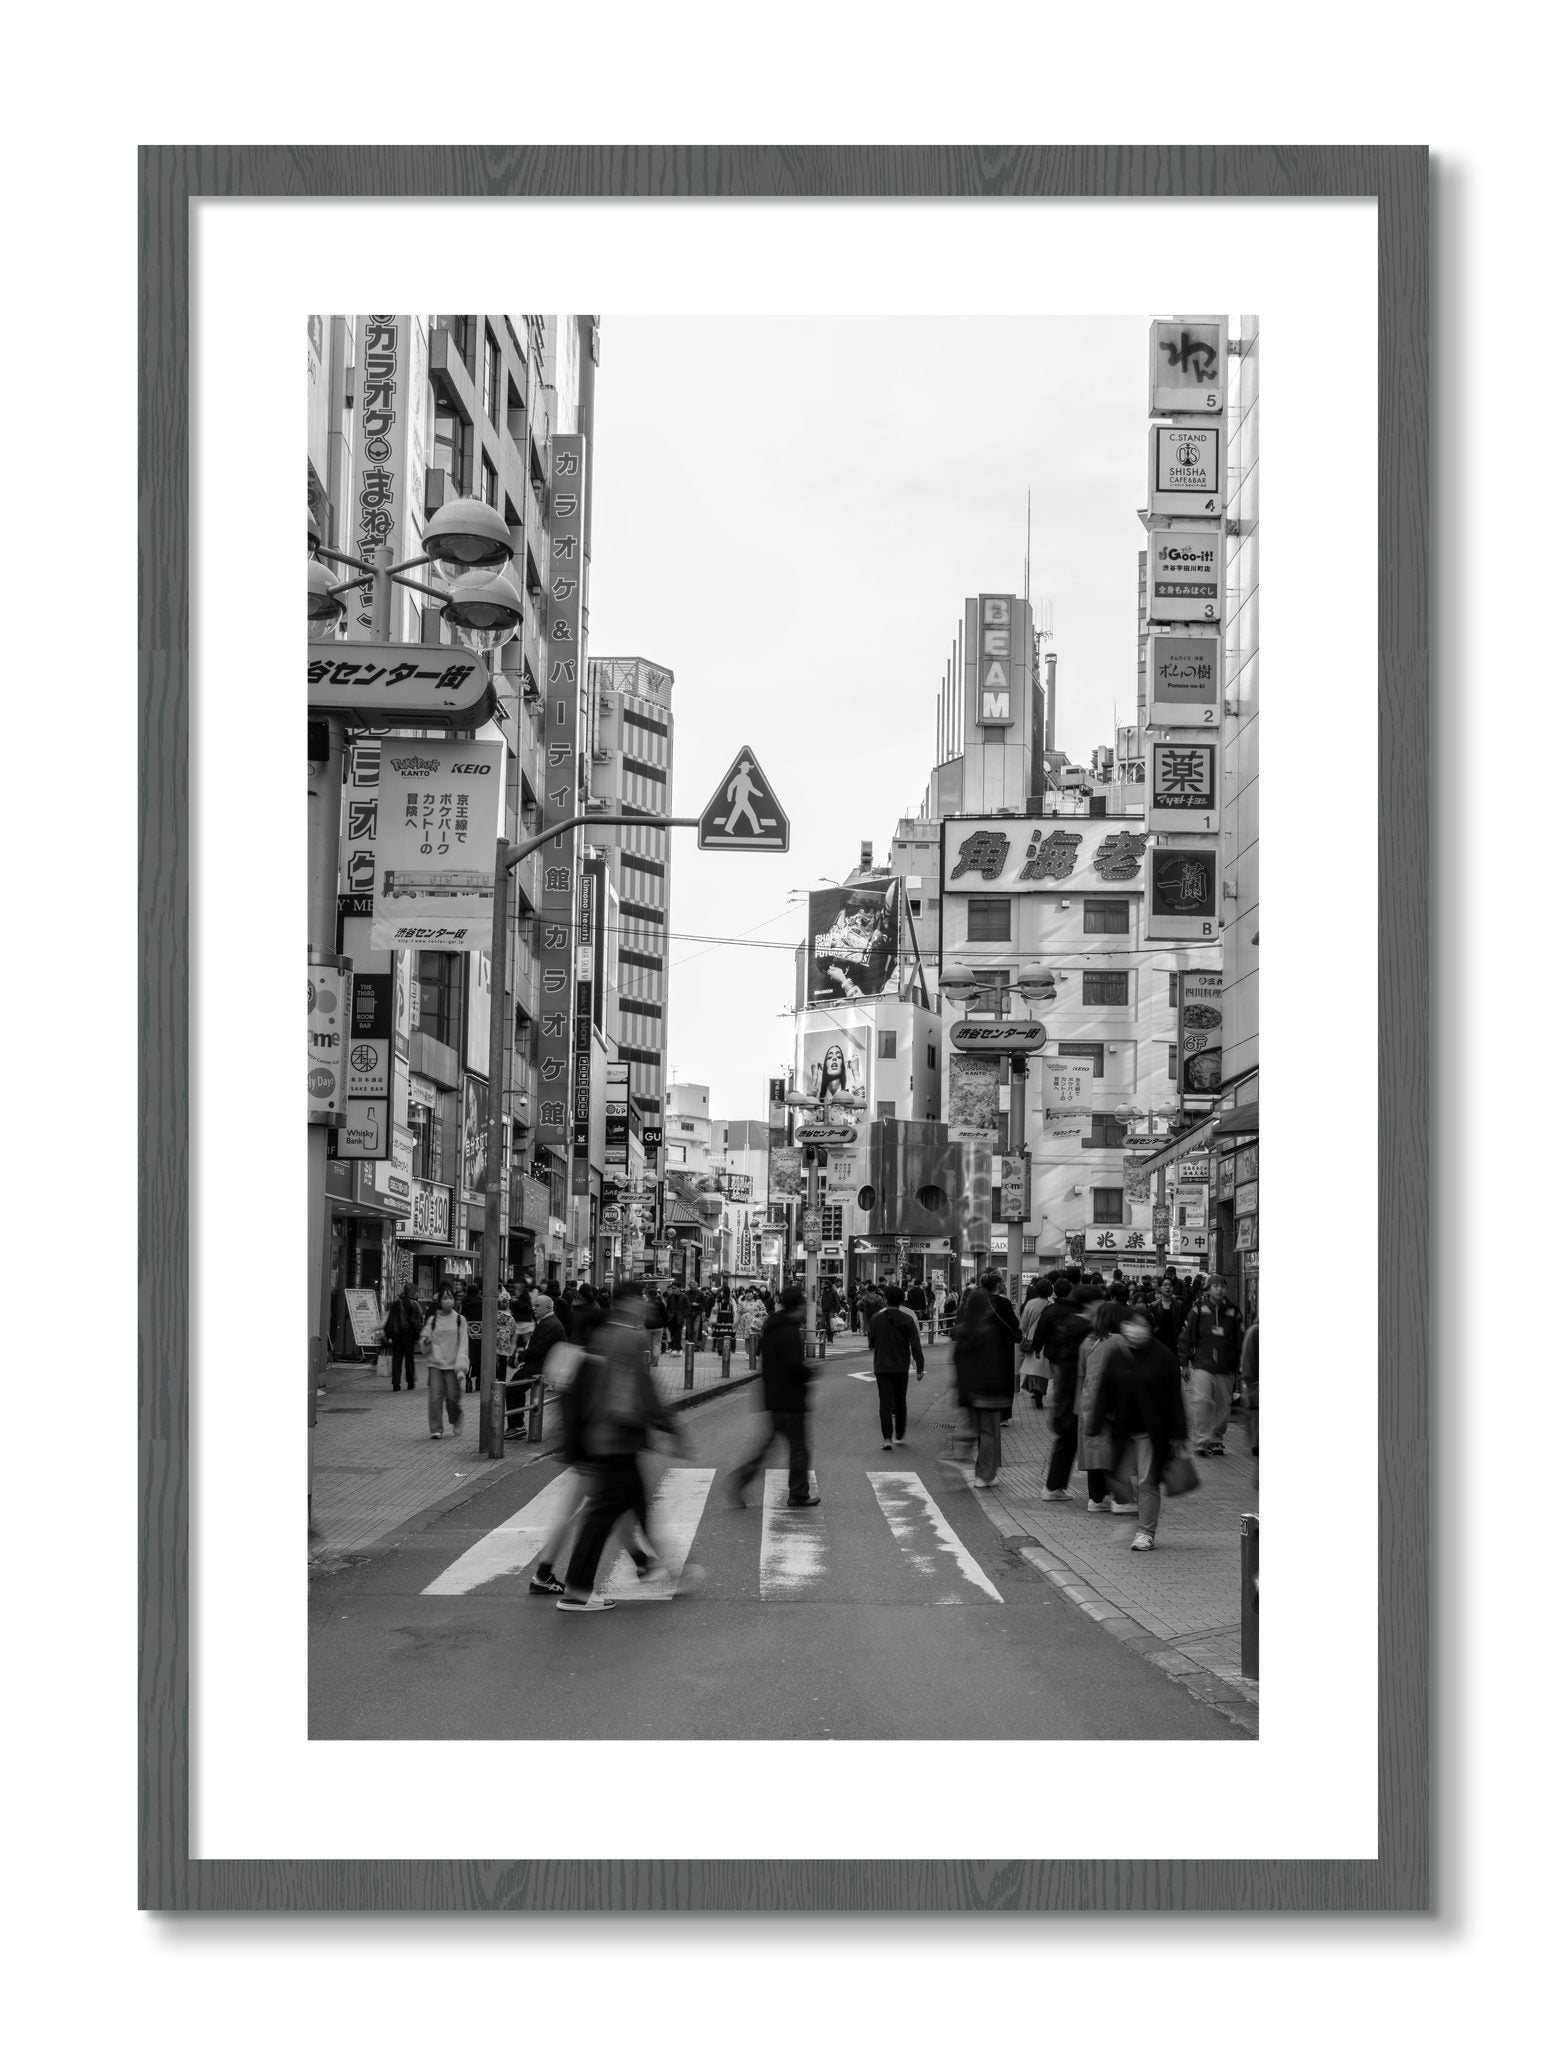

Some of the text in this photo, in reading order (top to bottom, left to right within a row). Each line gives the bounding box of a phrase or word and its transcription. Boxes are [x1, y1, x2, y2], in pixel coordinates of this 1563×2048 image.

[363, 324, 398, 439] カラオケ
[1206, 395, 1217, 407] 5
[1169, 434, 1207, 442] C.STAND
[1169, 467, 1207, 476] SHISHA
[1205, 499, 1216, 512] 4
[1158, 585, 1214, 595] 全身もみほぐし
[1204, 604, 1214, 618] 3
[983, 599, 1009, 718] BEAM
[1204, 710, 1214, 723] 2
[451, 763, 492, 775] KEIO
[1161, 750, 1204, 793] 薬
[405, 793, 419, 829] 冒険へ
[420, 793, 435, 855] カントーの
[455, 794, 470, 844] 京王線で
[1203, 816, 1211, 829] 1
[951, 830, 1150, 880] 角海老
[1157, 863, 1208, 902] 一蘭
[582, 879, 590, 910] kimono
[394, 928, 468, 939] 渋谷センター街
[1202, 922, 1213, 936] B
[956, 1028, 1041, 1039] 渋谷センター街
[1184, 1036, 1208, 1052] 6F
[347, 1129, 374, 1139] Whisky
[644, 1132, 661, 1141] GU
